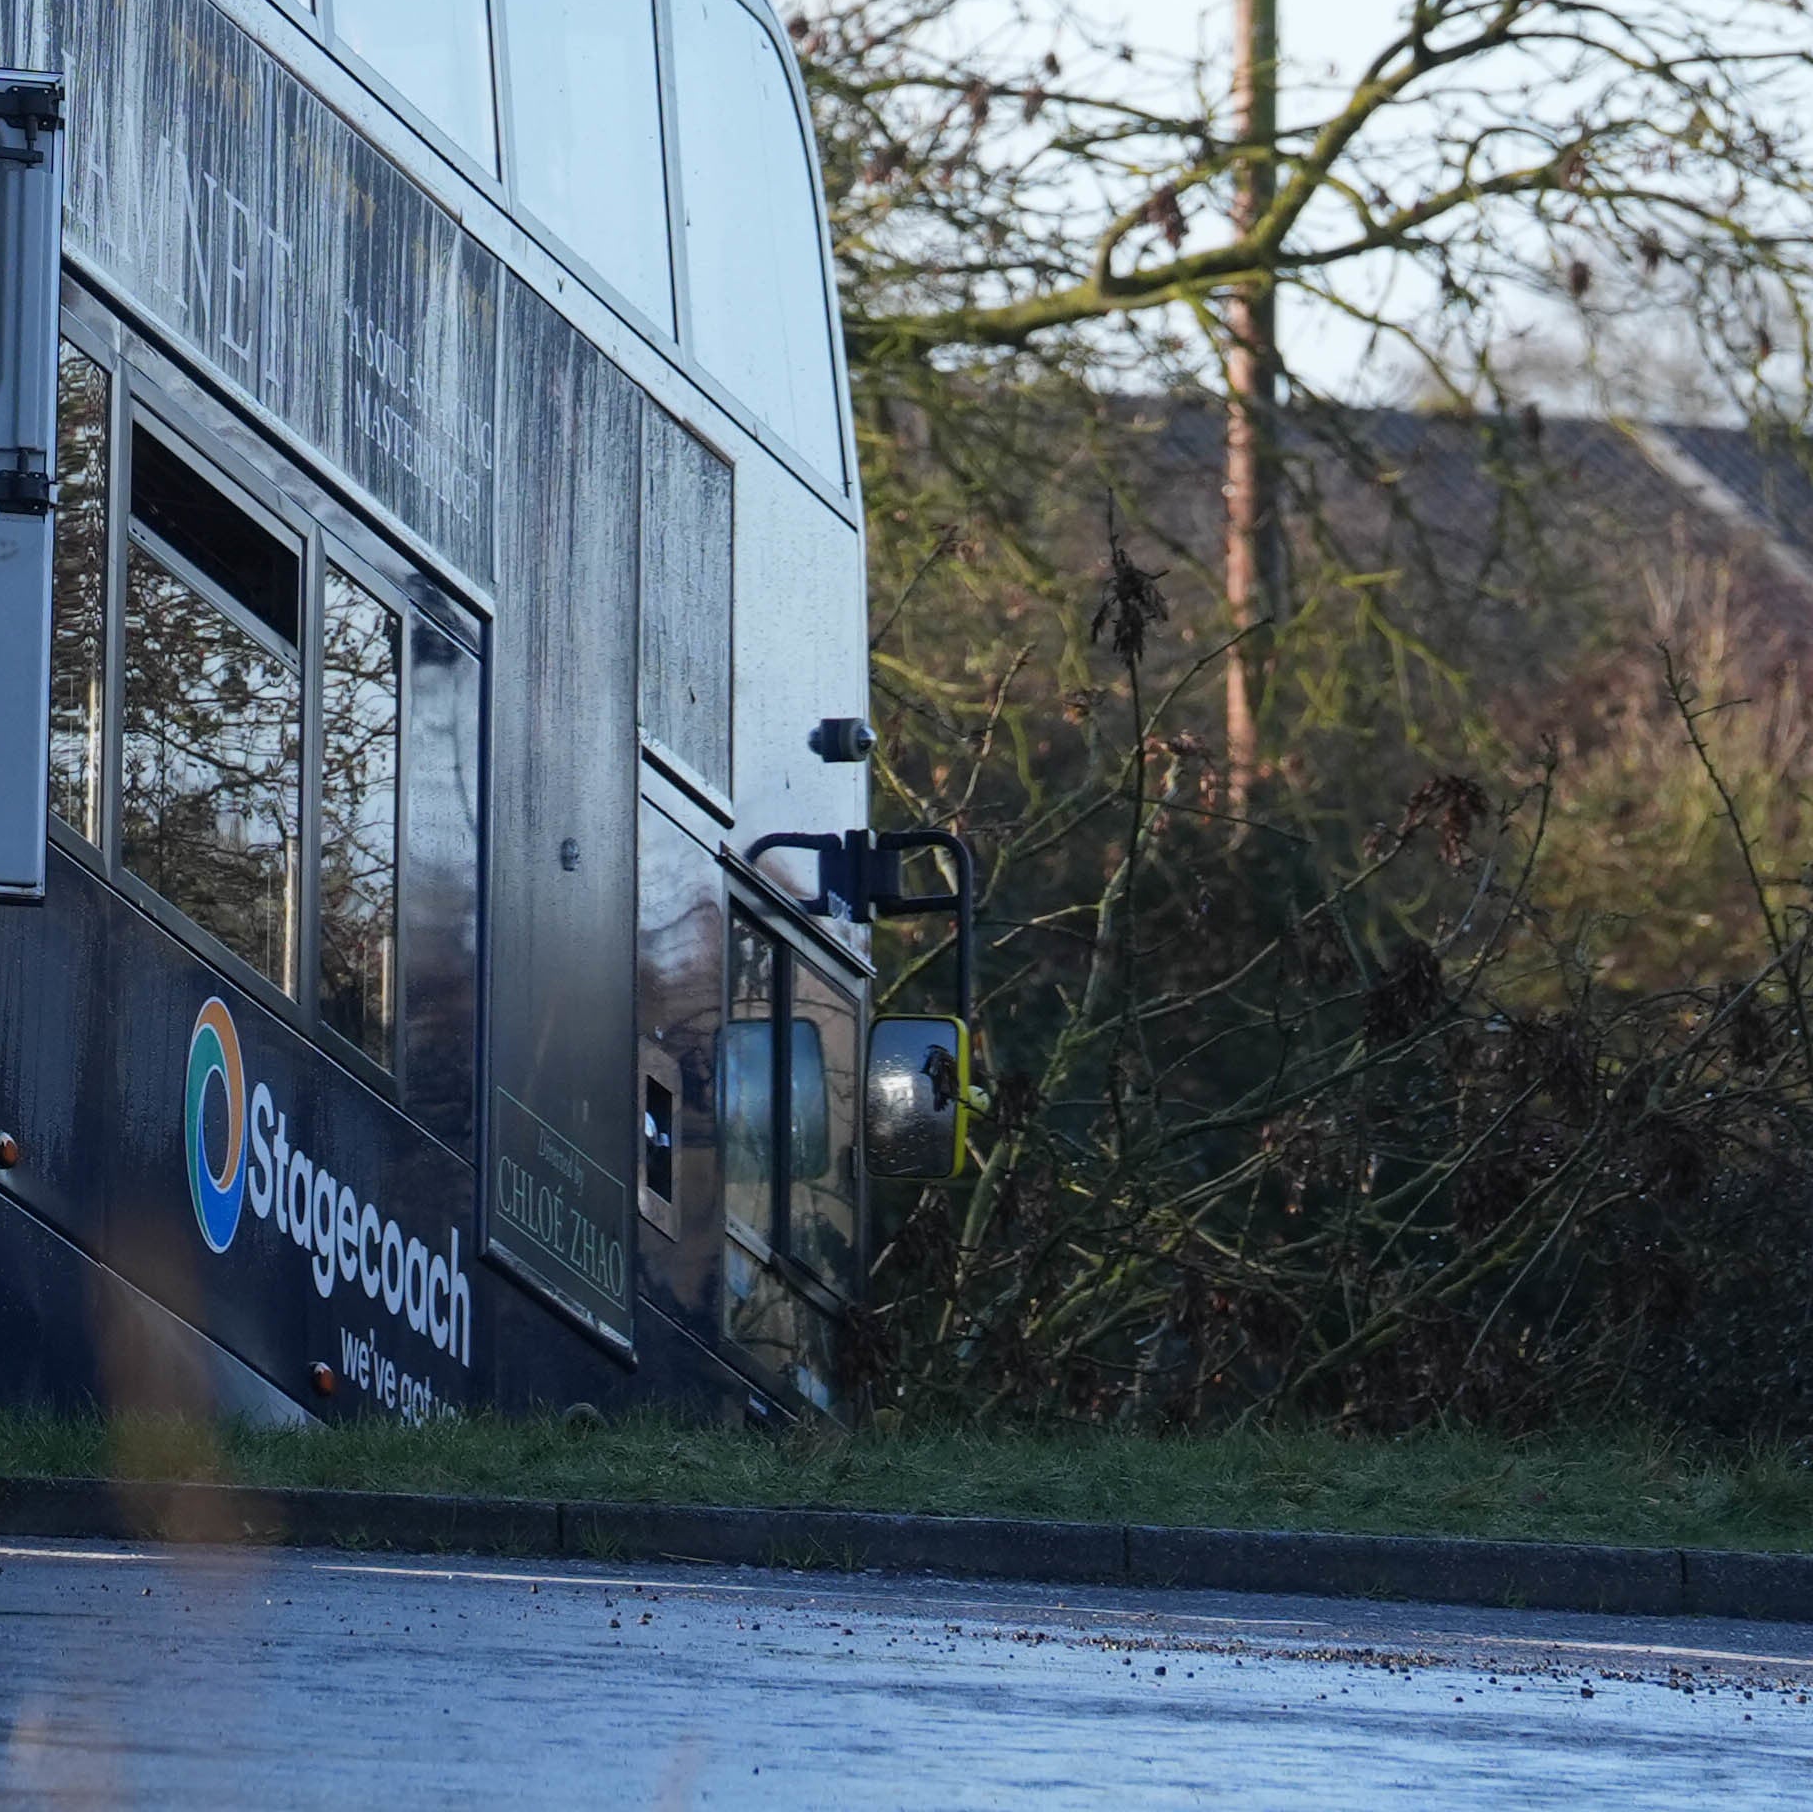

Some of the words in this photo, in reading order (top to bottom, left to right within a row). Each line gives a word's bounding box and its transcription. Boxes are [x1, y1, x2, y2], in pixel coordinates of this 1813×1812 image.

[248, 1082, 470, 1368] Stagecoach
[498, 1155, 565, 1254] CHLOÉ
[571, 1208, 623, 1297] ZHAO
[340, 1326, 396, 1409] we've
[400, 1373, 432, 1429] got
